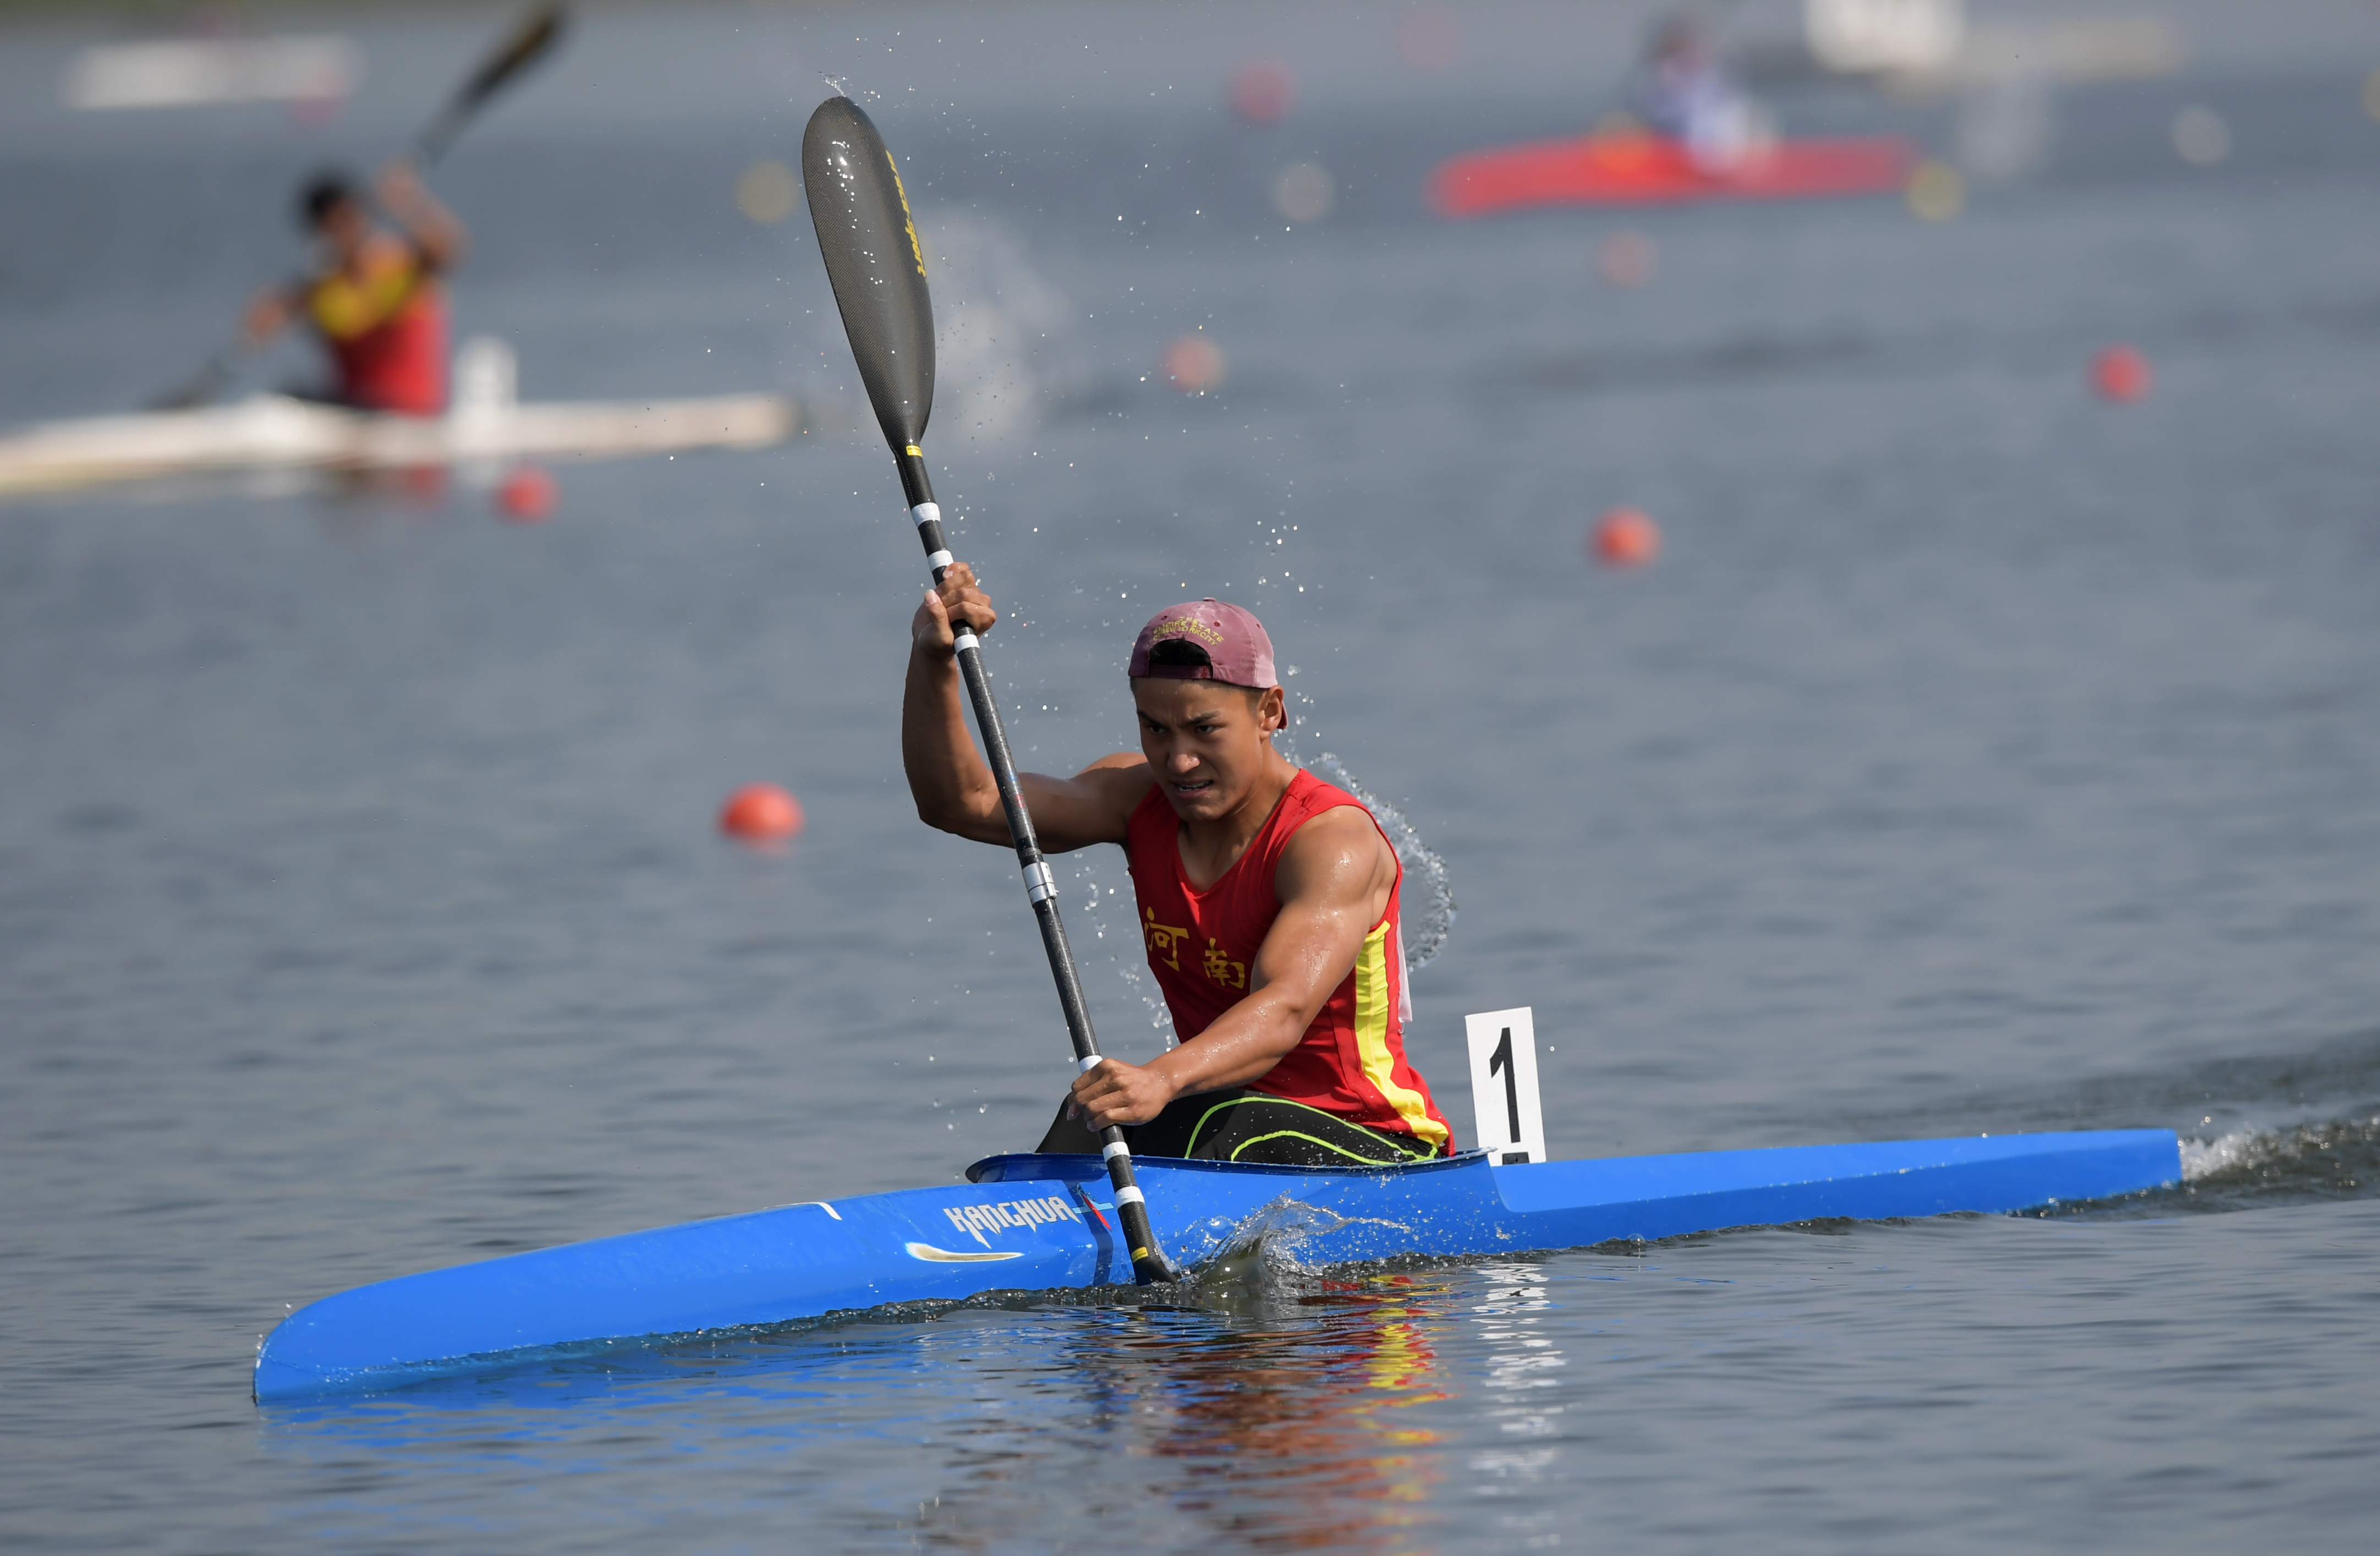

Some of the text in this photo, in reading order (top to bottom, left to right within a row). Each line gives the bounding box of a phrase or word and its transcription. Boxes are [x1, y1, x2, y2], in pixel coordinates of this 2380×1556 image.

[1153, 621, 1224, 643] EMPIRE STATE
[1200, 632, 1217, 646] CITY
[1144, 906, 1245, 989] 河南
[1490, 1027, 1521, 1143] 1
